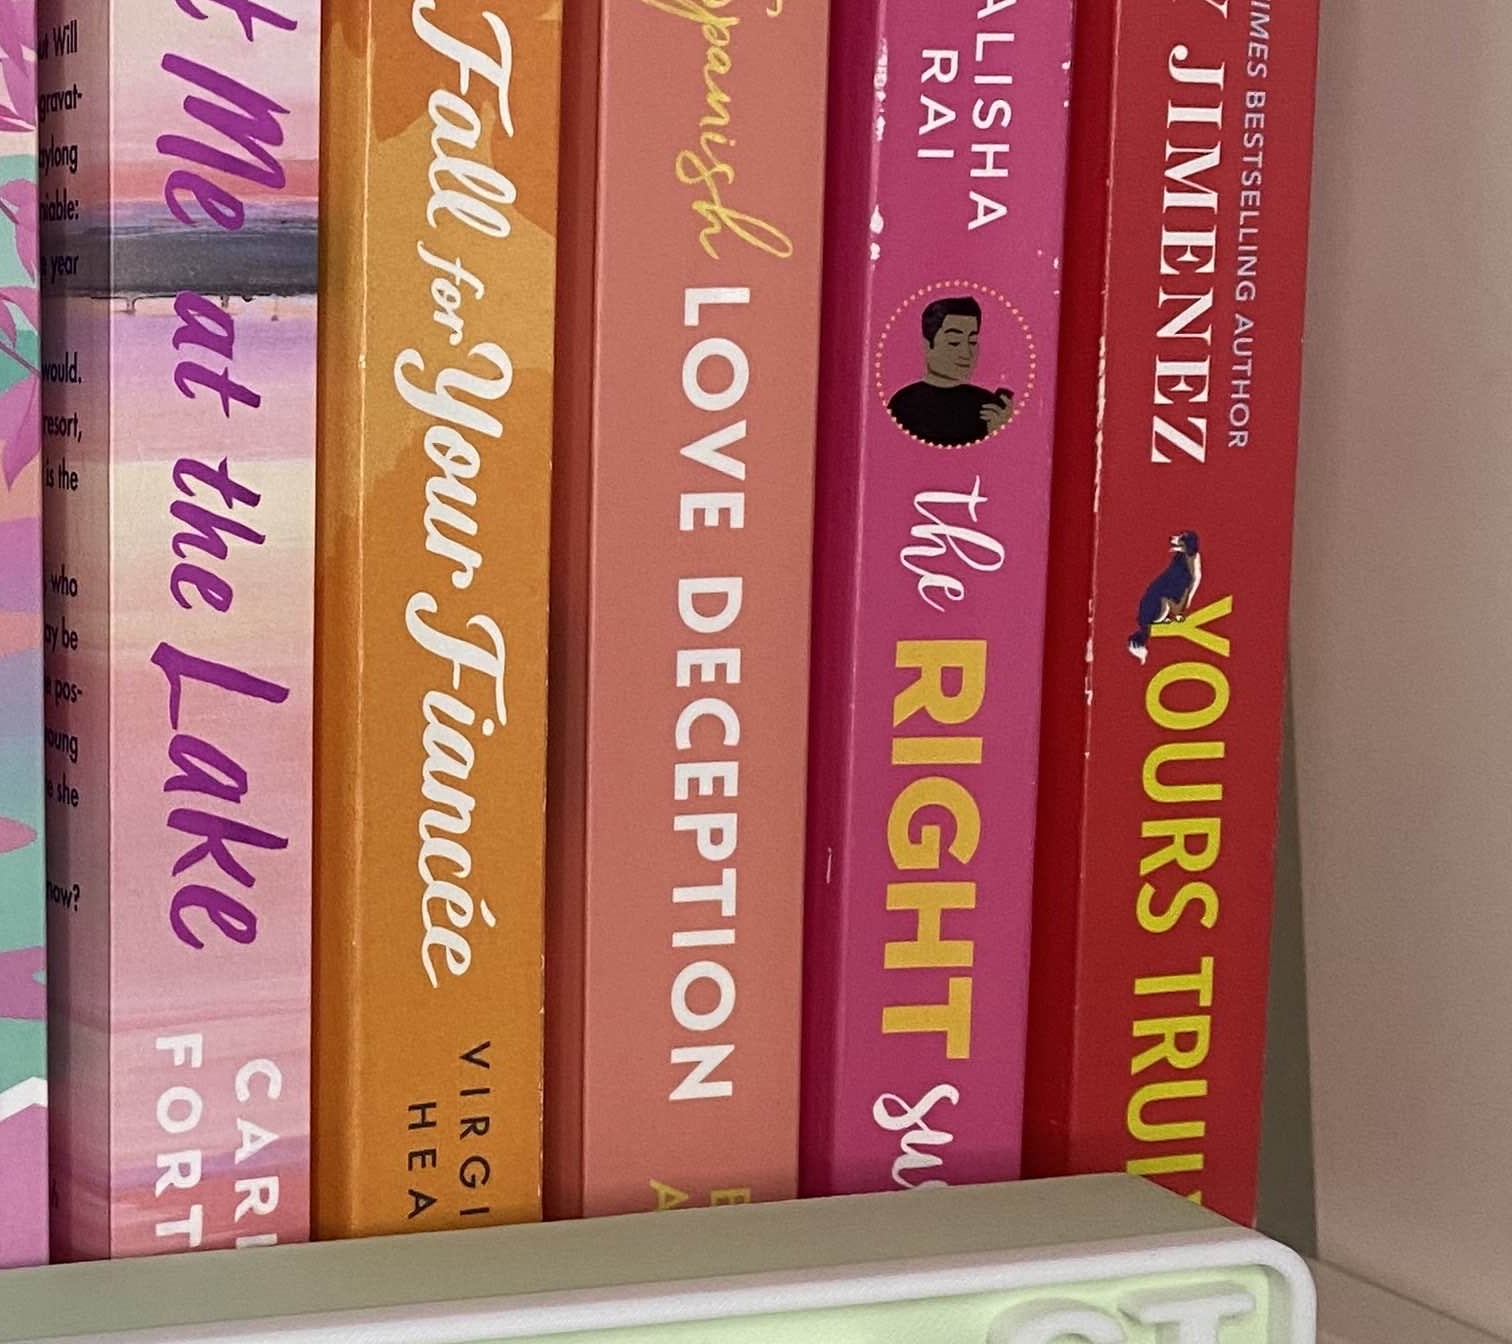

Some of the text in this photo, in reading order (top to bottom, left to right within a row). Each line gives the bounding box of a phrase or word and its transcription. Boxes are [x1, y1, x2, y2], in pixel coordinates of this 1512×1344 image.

[53, 18, 79, 56] Will
[918, 47, 960, 160] RAI
[155, 52, 291, 232] Me
[1234, 87, 1268, 304] BESTSELLING
[417, 239, 485, 347] for
[1149, 45, 1225, 465] JIMENEZ
[172, 290, 262, 418] at
[679, 287, 751, 531] LOVE
[1226, 311, 1255, 451] AUTHOR
[58, 456, 79, 492] the
[169, 456, 266, 612] the
[393, 341, 514, 589] Your
[895, 473, 1006, 613] the
[51, 563, 79, 598] who
[62, 615, 79, 651] be
[56, 772, 79, 808] she
[149, 640, 290, 950] Lake
[405, 590, 508, 989] Fiancée
[668, 576, 744, 1102] DECEPTION
[1136, 594, 1233, 935] YOURS
[881, 638, 988, 1061] RIGHT
[155, 1032, 205, 1248] FORT
[408, 1101, 438, 1220] HEA
[459, 1040, 492, 1217] VIRGI
